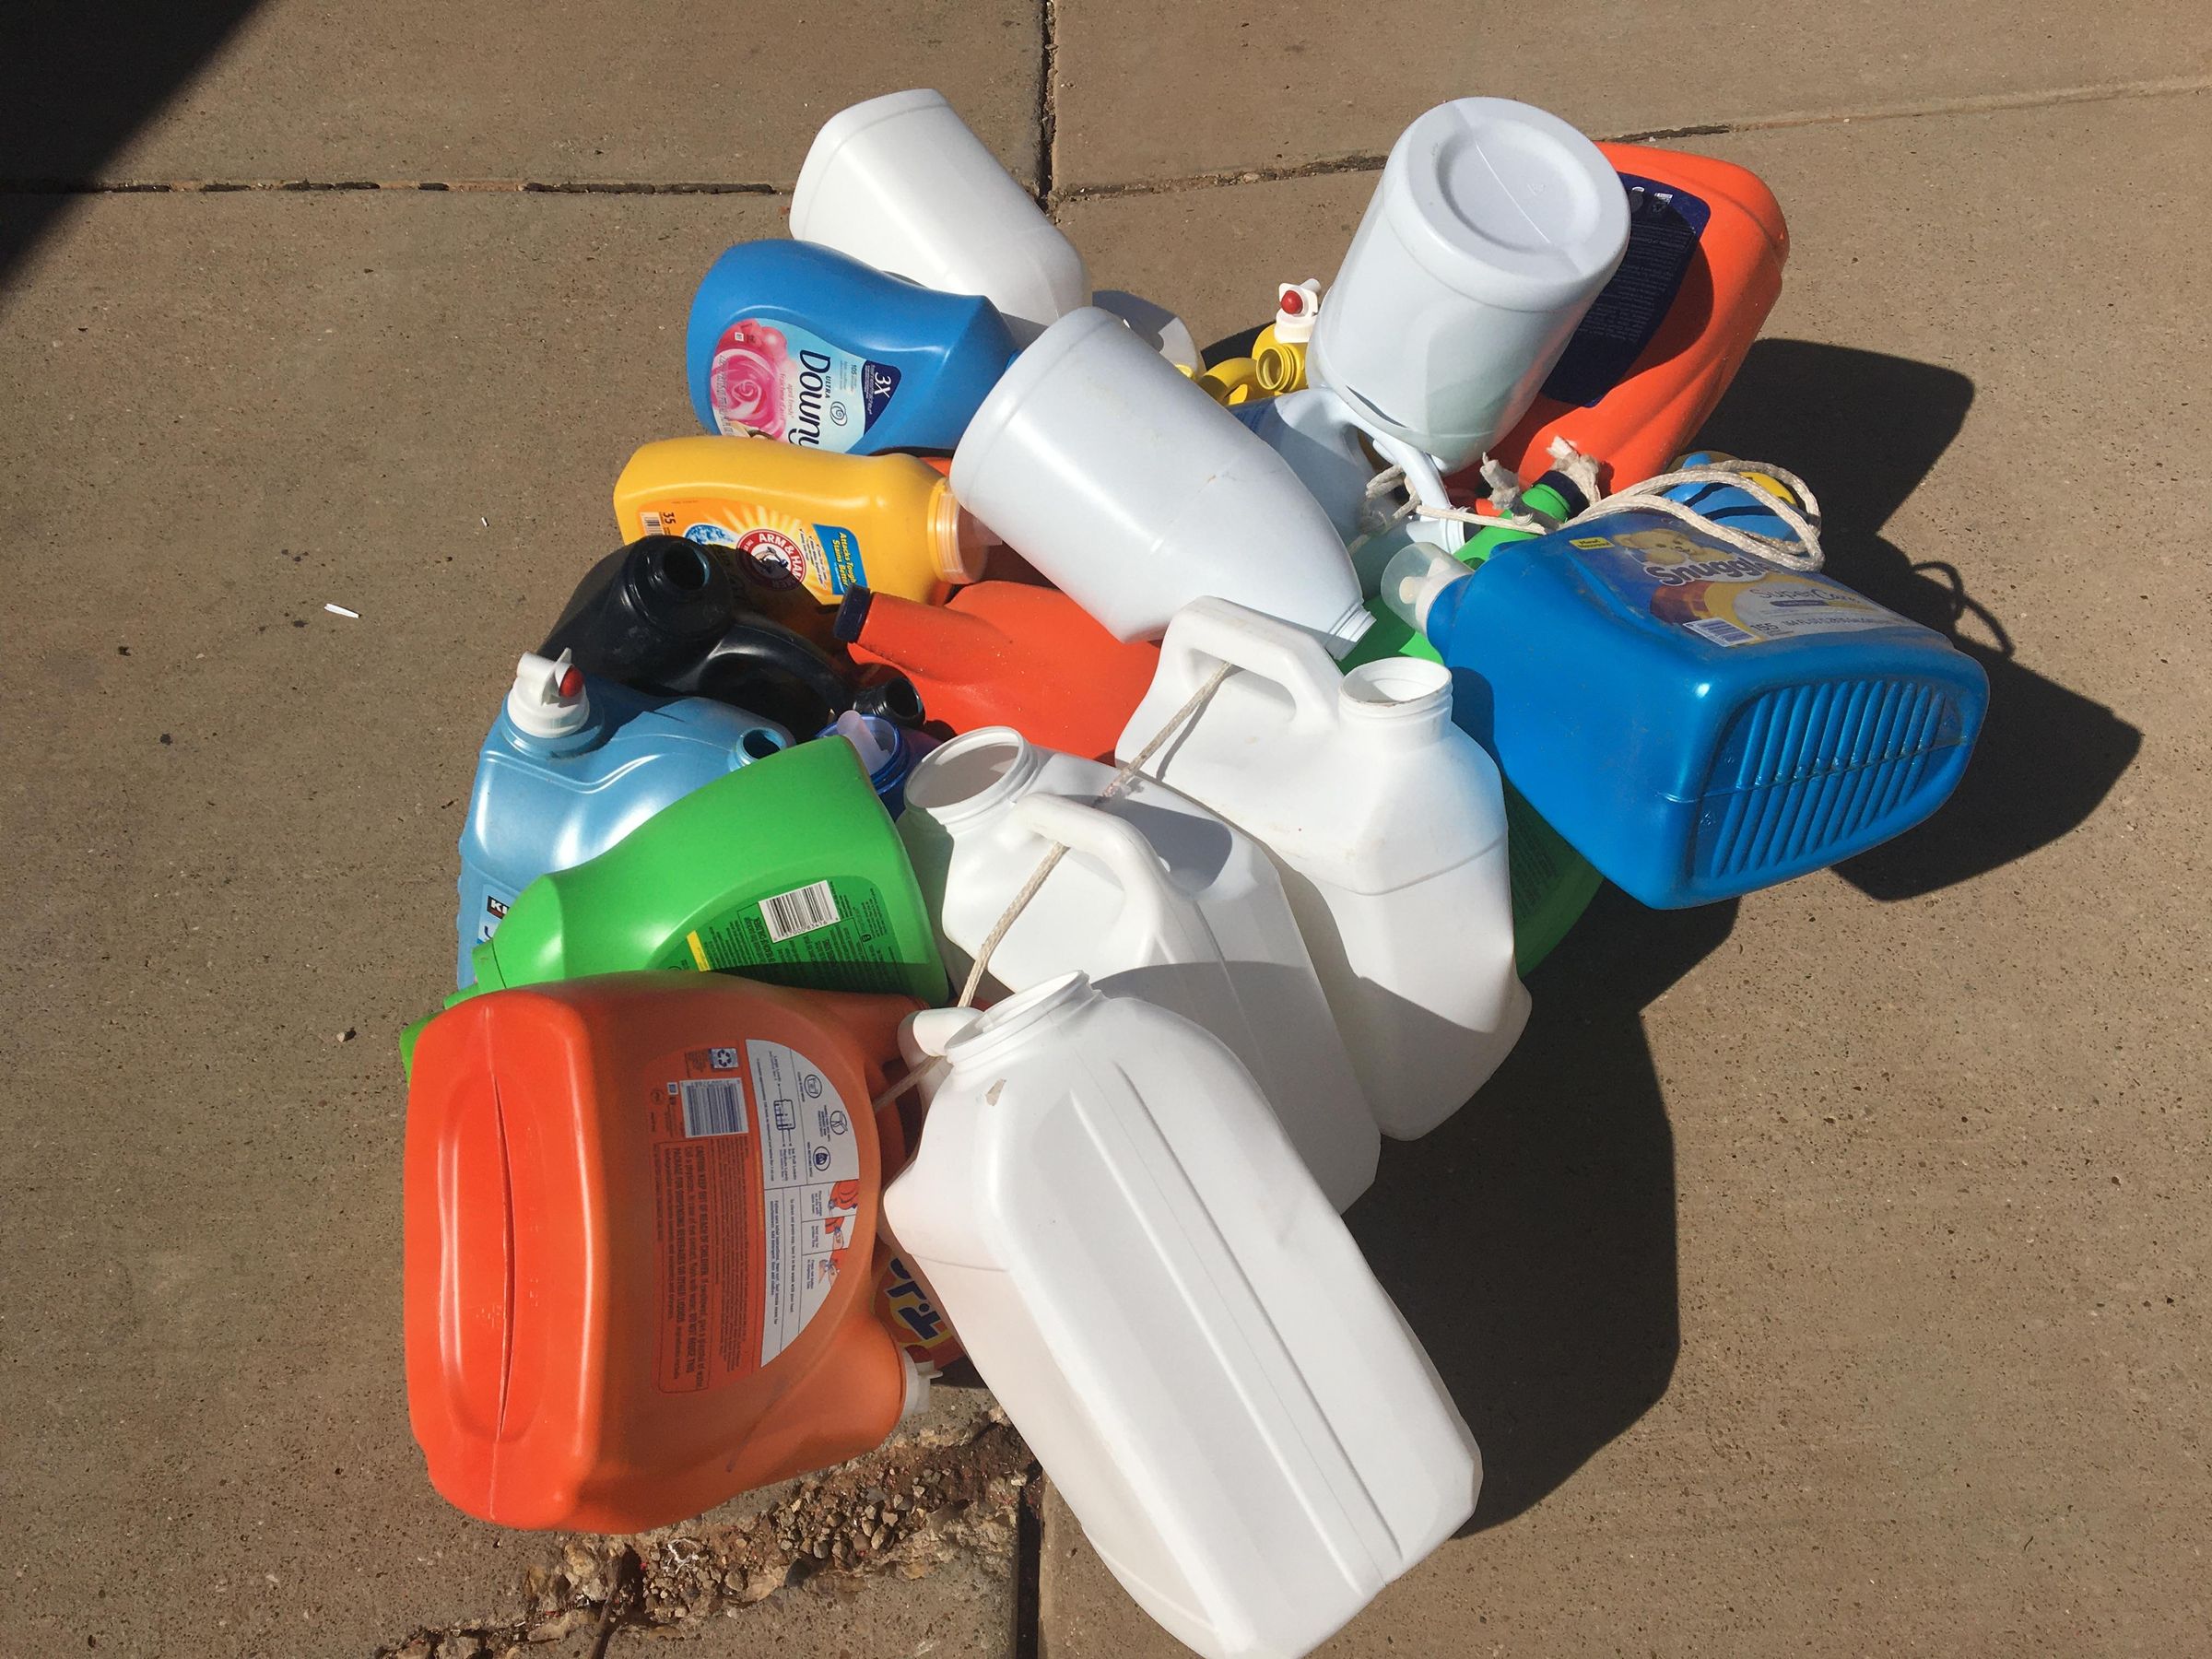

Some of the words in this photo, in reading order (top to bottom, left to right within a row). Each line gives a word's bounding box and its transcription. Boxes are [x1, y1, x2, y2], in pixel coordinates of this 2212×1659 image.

[789, 349, 831, 447] Downy
[875, 372, 891, 398] 3X
[663, 512, 677, 524] 35
[759, 533, 786, 547] ARM
[784, 546, 794, 555] &
[832, 539, 843, 562] Stains
[838, 564, 849, 586] Better
[839, 532, 851, 560] Attacks
[846, 562, 857, 583] Tough
[888, 1258, 941, 1340] Td
